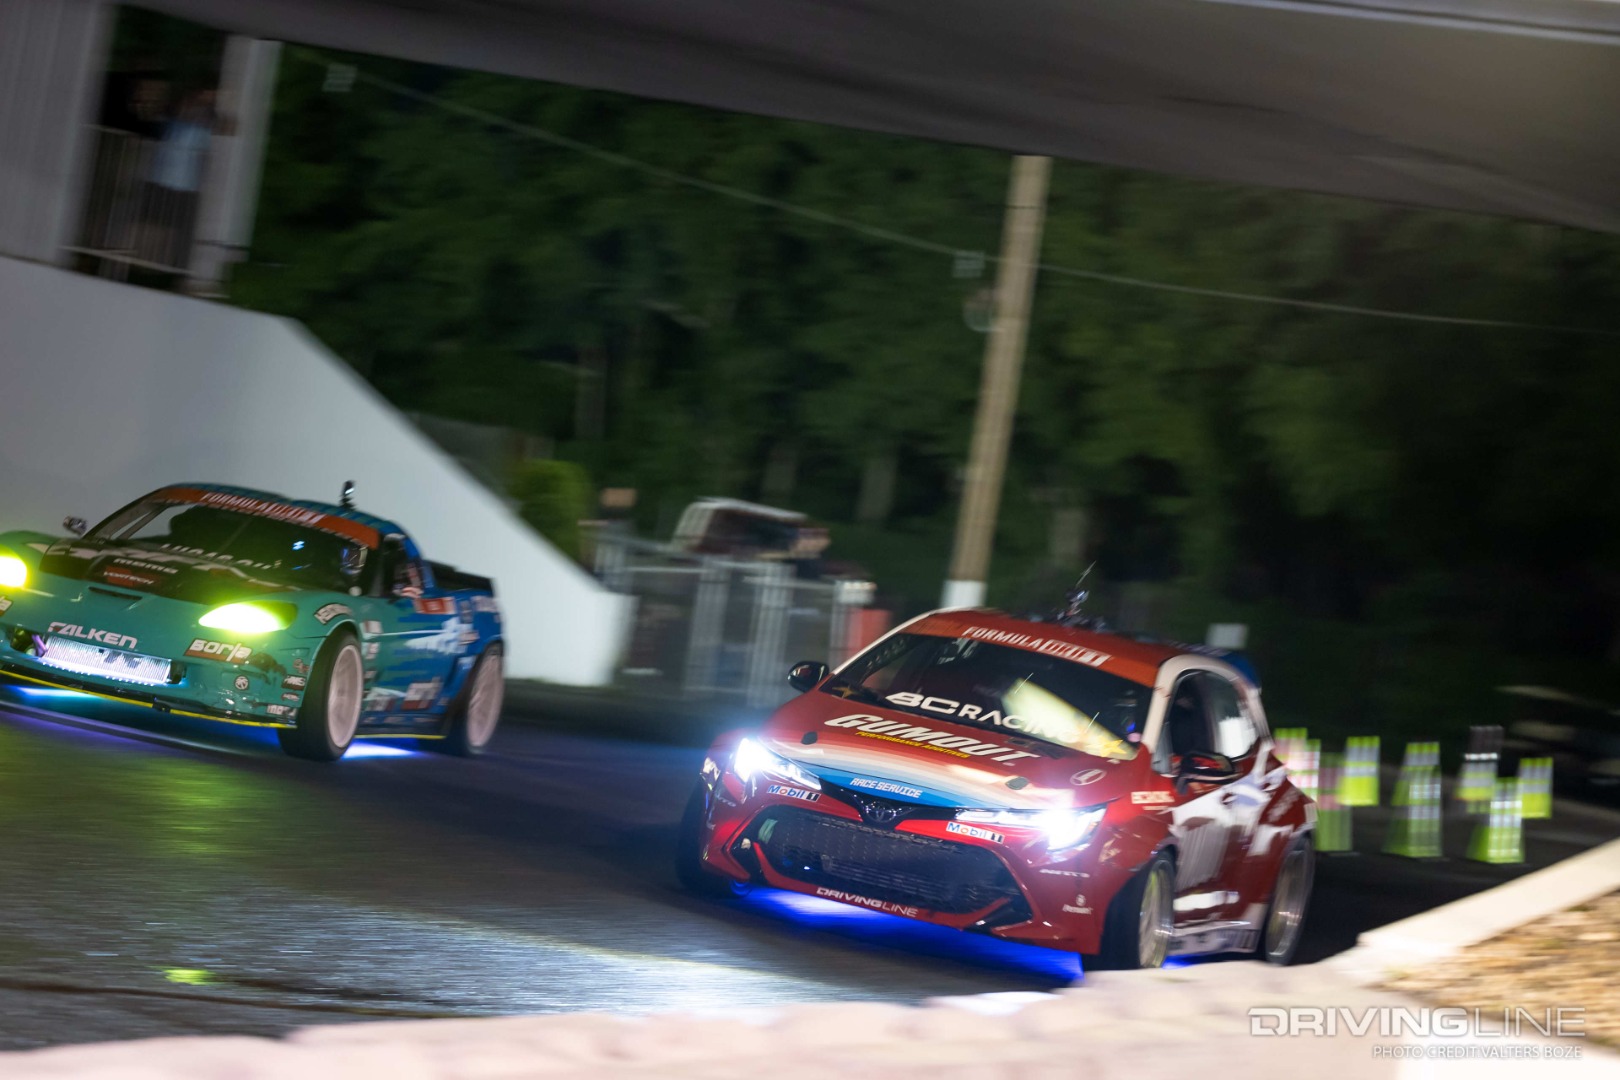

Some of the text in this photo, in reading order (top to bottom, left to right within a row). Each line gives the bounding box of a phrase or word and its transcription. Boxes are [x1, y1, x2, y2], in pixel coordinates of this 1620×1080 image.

[47, 621, 138, 649] FALKEN
[961, 626, 1045, 649] FORMULA
[824, 713, 1041, 763] GUMOUT
[767, 784, 806, 799] Mobil
[850, 777, 923, 799] RACE SERVICE
[947, 822, 988, 839] Mobil
